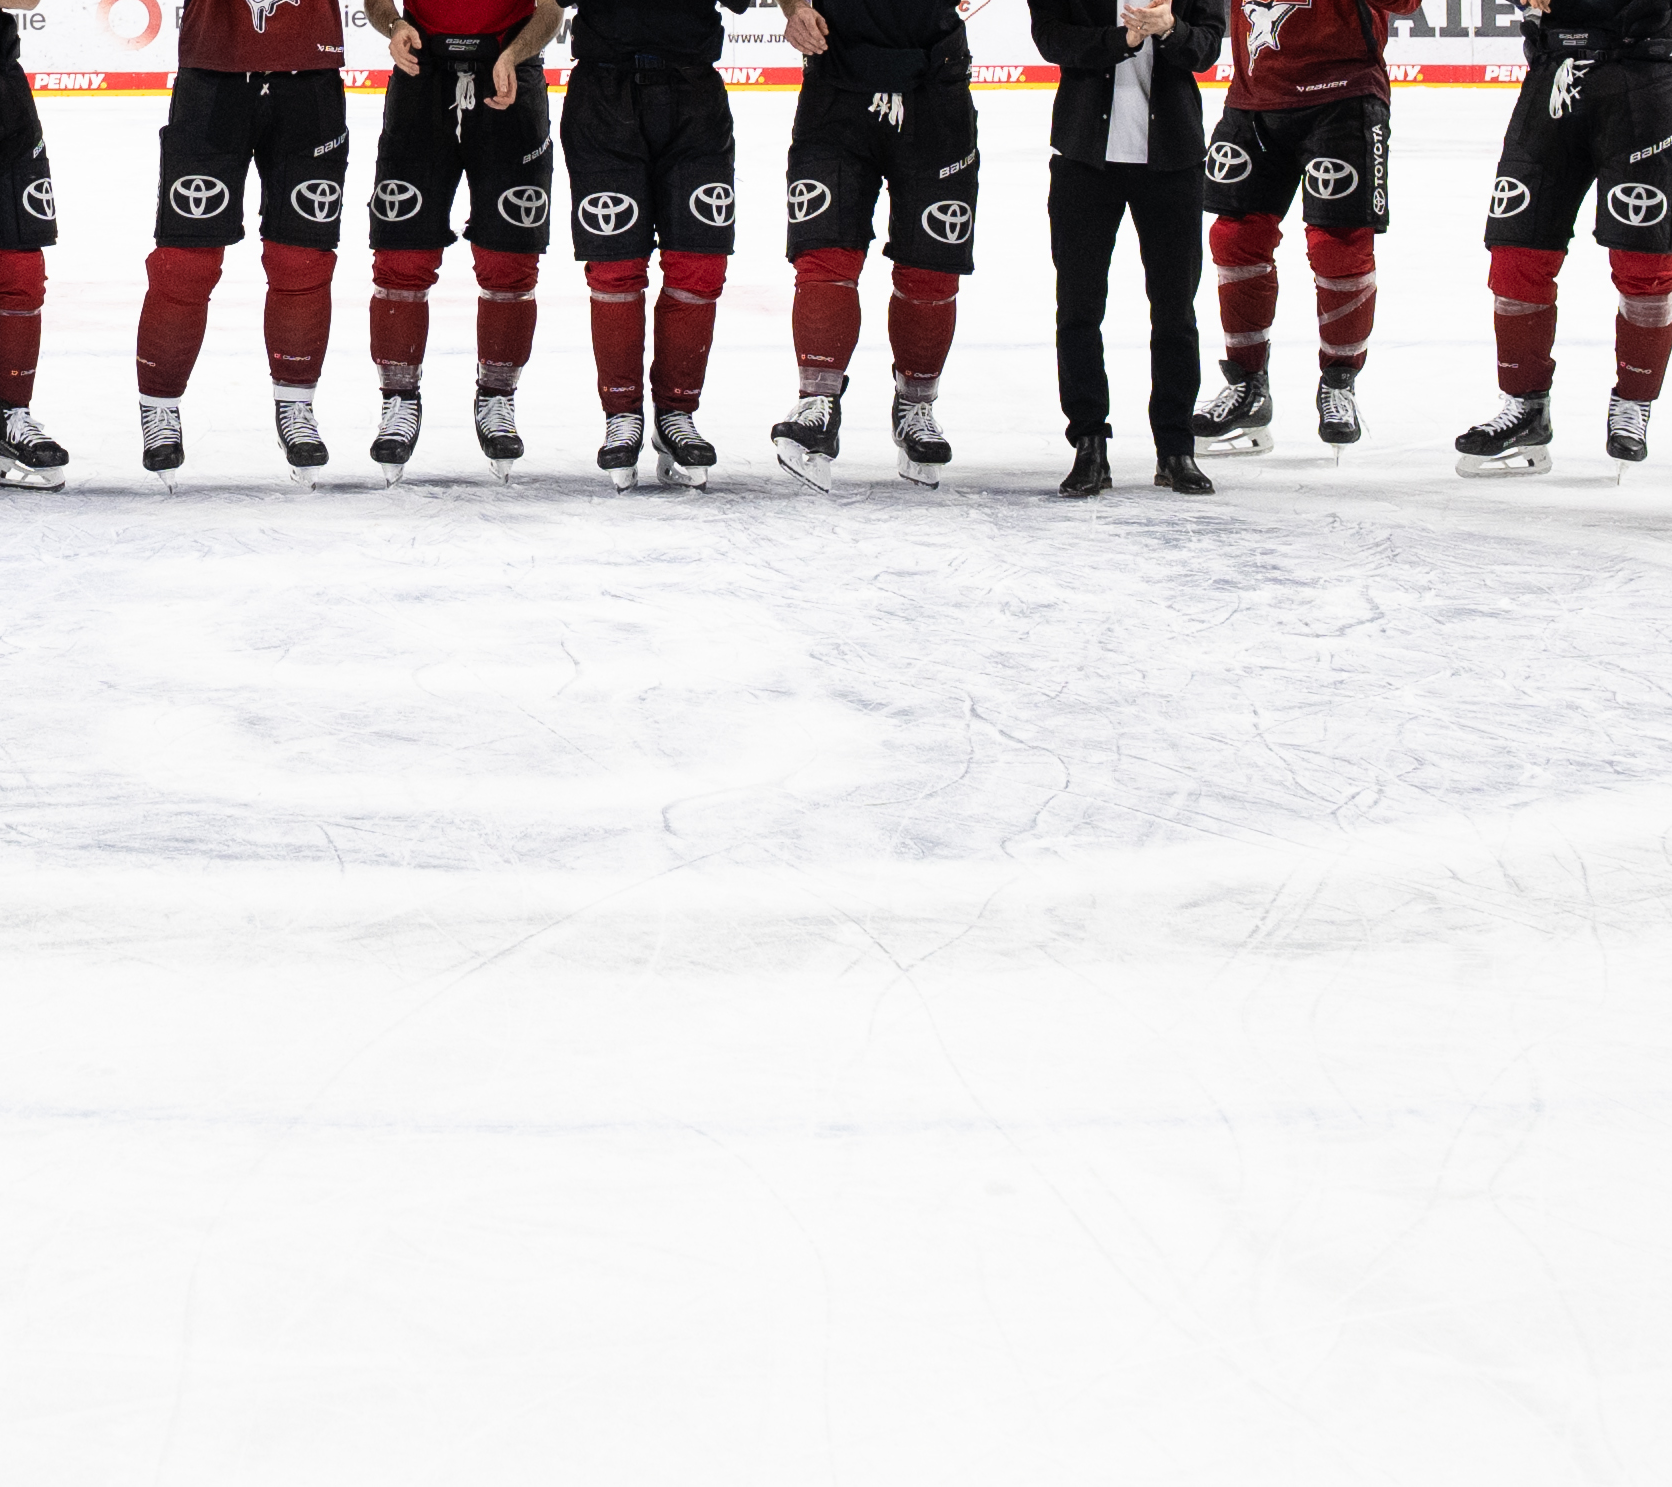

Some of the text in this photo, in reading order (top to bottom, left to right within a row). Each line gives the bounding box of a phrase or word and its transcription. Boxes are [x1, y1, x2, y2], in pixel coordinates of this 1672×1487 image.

[1485, 66, 1528, 81] PEN
[1305, 79, 1348, 92] BAUER
[1372, 123, 1384, 186] TOYOTA
